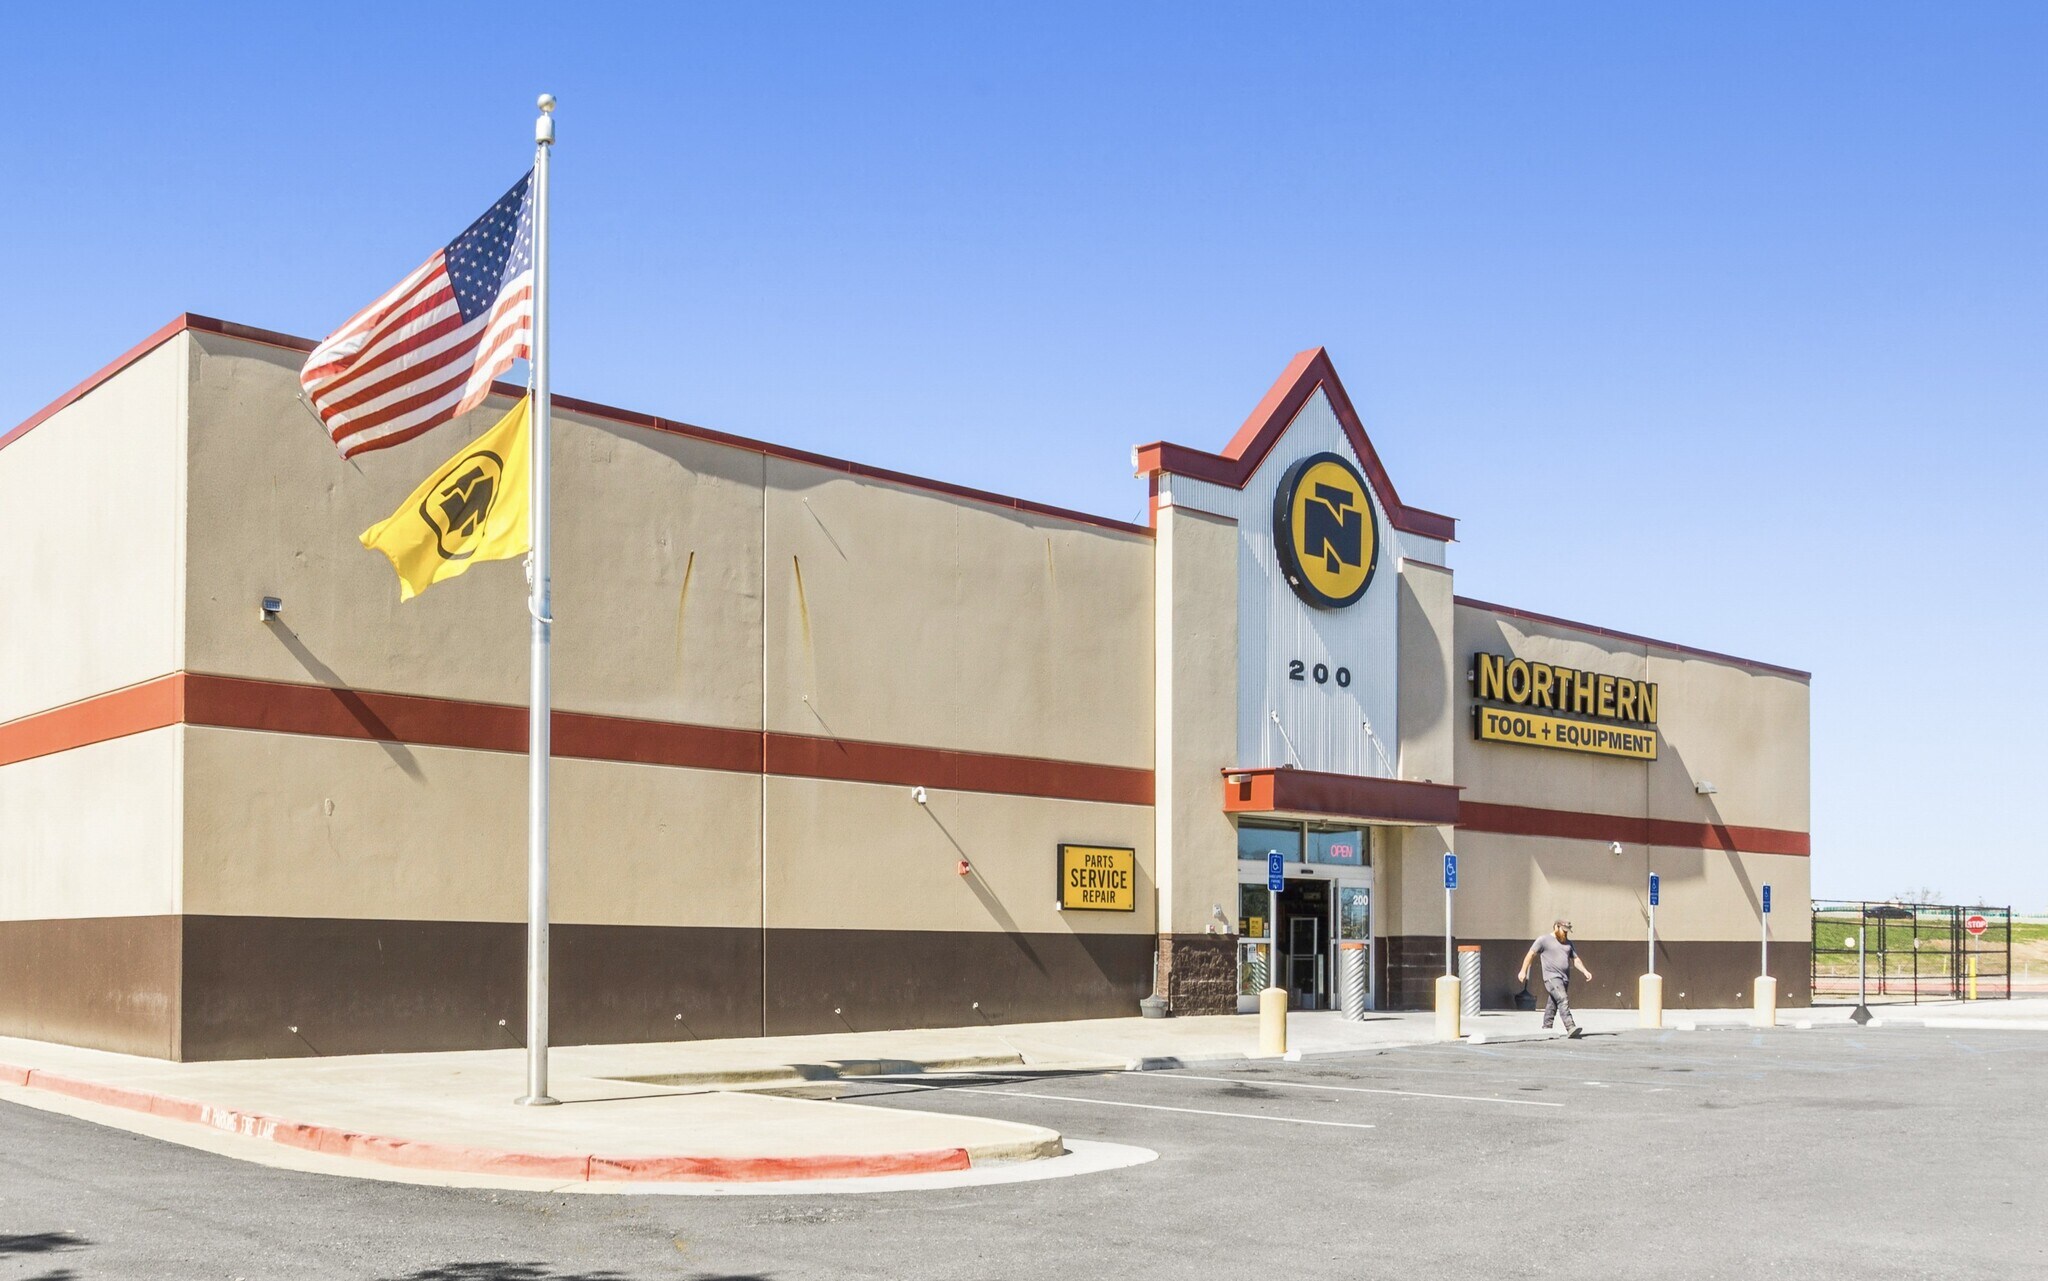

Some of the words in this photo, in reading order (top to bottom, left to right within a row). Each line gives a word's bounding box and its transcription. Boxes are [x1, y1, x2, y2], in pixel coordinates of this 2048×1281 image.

[1304, 482, 1362, 574] N
[1289, 660, 1351, 688] 200
[1475, 652, 1658, 724] NORTHERN
[1487, 714, 1536, 739] TOOL
[1556, 724, 1652, 753] EQUIPMENT
[1330, 844, 1353, 858] OPEN
[1085, 854, 1114, 868] PARTS
[1070, 868, 1127, 889] SERVICE
[1082, 890, 1116, 903] REPAIR
[1352, 894, 1369, 906] 200
[1966, 920, 1987, 928] STOP
